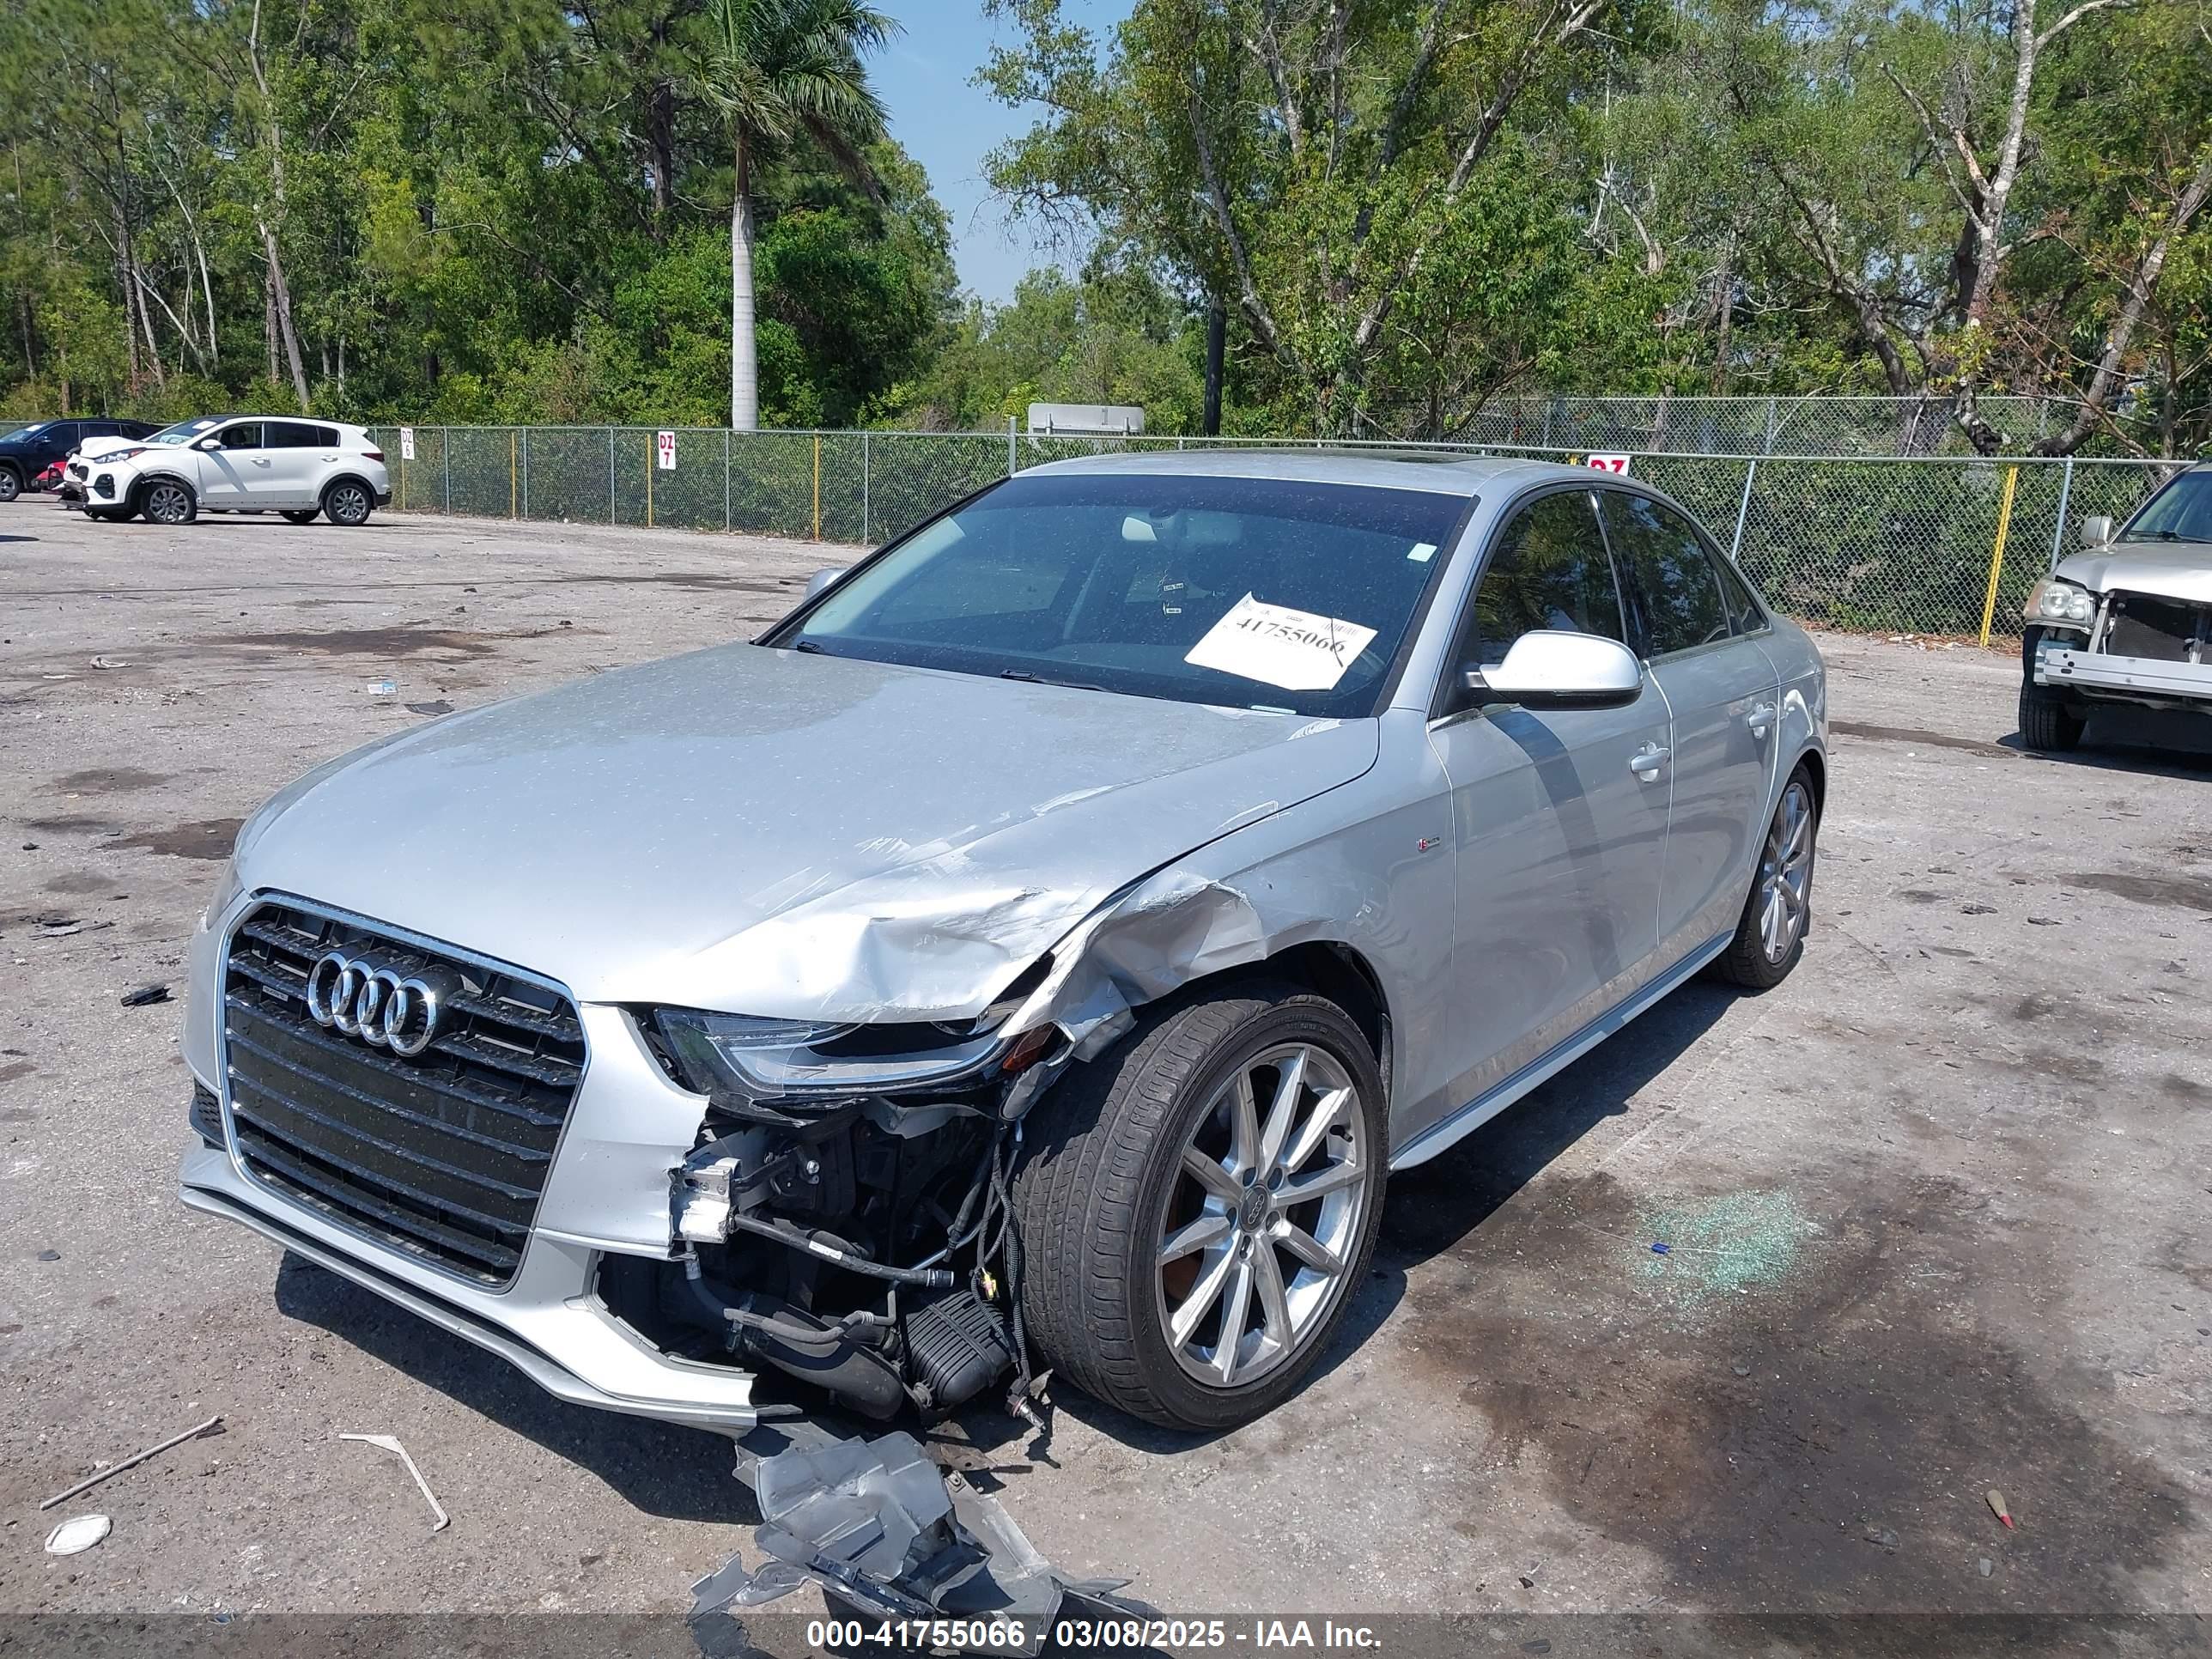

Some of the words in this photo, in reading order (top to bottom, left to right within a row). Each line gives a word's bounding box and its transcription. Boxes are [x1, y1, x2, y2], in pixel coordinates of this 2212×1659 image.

[402, 430, 412, 443] DZ
[659, 434, 674, 449] DZ
[405, 445, 410, 457] 6
[664, 452, 670, 465] 7
[1236, 617, 1348, 653] 41755066
